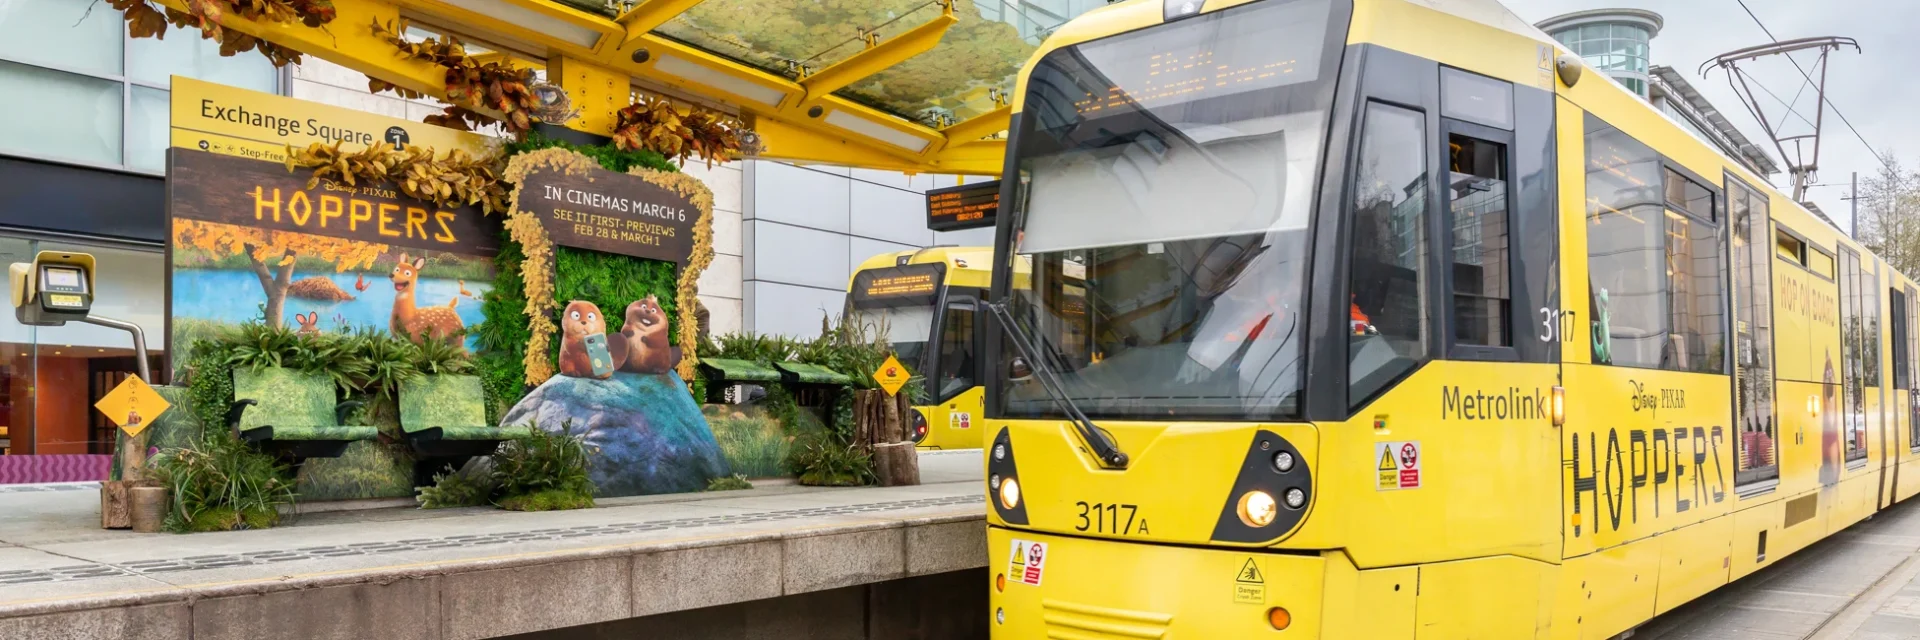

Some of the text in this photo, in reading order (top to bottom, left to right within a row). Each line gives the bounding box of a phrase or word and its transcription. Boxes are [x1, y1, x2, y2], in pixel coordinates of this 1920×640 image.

[201, 99, 373, 146] Exchange Square
[390, 128, 405, 137] ZONE
[240, 146, 284, 162] Step-Free
[392, 134, 401, 149] 1
[321, 178, 397, 199] Disney PIXAR
[544, 185, 686, 222] IN CINEMAS MARCH 6
[252, 186, 457, 243] HOPPERS
[553, 209, 573, 222] SEE
[575, 212, 589, 223] IT
[626, 220, 675, 237] PREVIEWS
[574, 224, 660, 246] FEB 28 & MARCH 1
[1780, 273, 1798, 313] HOP
[1540, 307, 1576, 342] 3117
[1442, 385, 1546, 420] Metrolink
[1629, 379, 1686, 420] Disney PIXAR
[1571, 425, 1726, 538] HOPPERS
[1238, 587, 1261, 596] Danger
